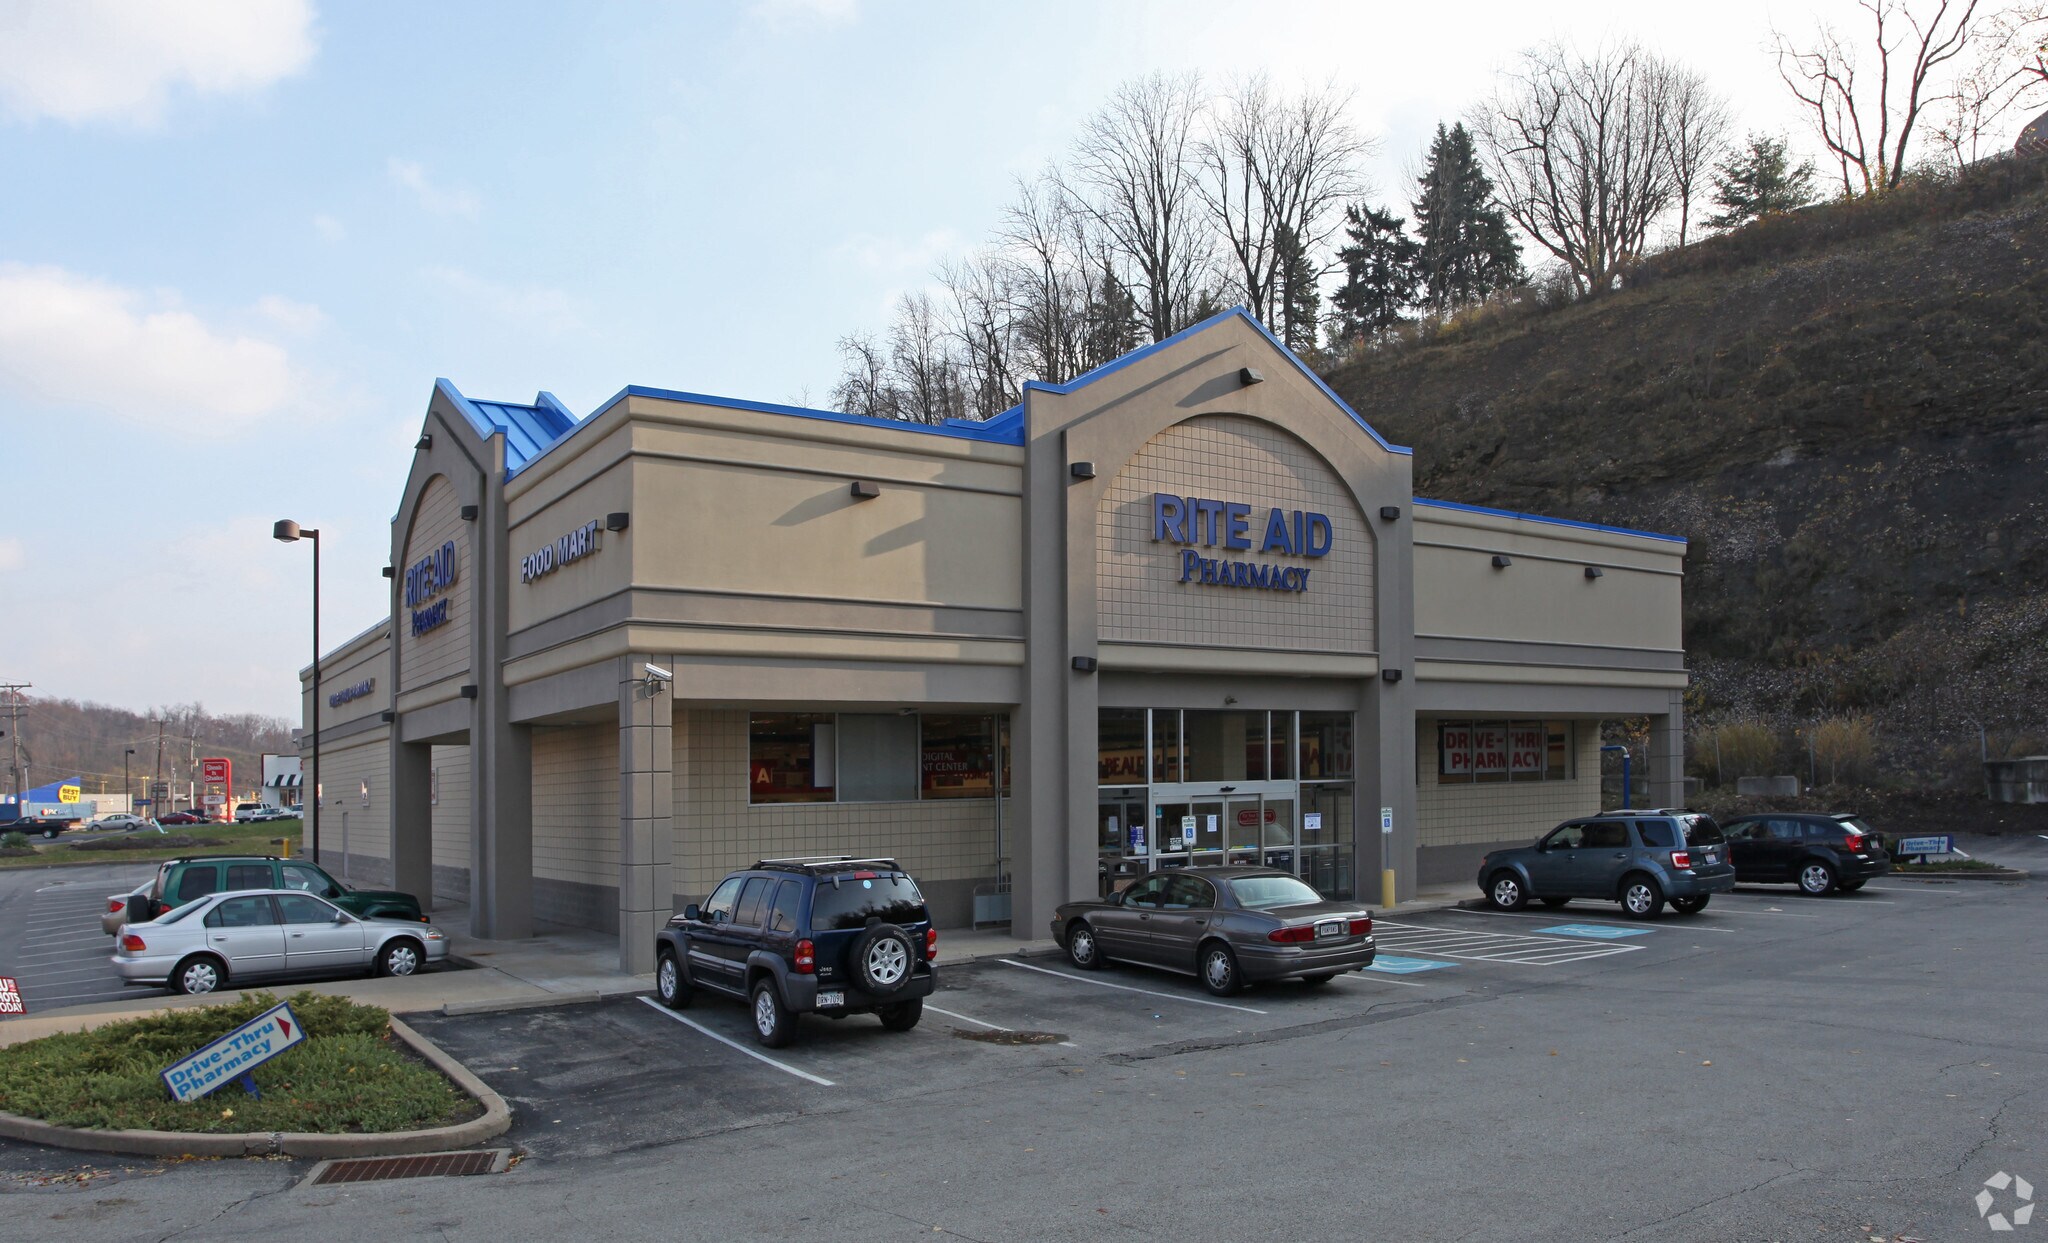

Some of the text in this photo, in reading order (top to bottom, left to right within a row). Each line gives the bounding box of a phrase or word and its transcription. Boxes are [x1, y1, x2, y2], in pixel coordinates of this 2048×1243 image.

[521, 519, 598, 584] FOOD MART
[1154, 492, 1333, 558] RITE AID
[406, 540, 455, 608] RITE AID
[1180, 549, 1311, 592] PHARMACY
[935, 762, 967, 771] CENTER
[1445, 732, 1546, 749] DRVE-HR
[169, 1022, 274, 1086] Drive-Thru
[176, 1038, 272, 1098] Pharmacy
